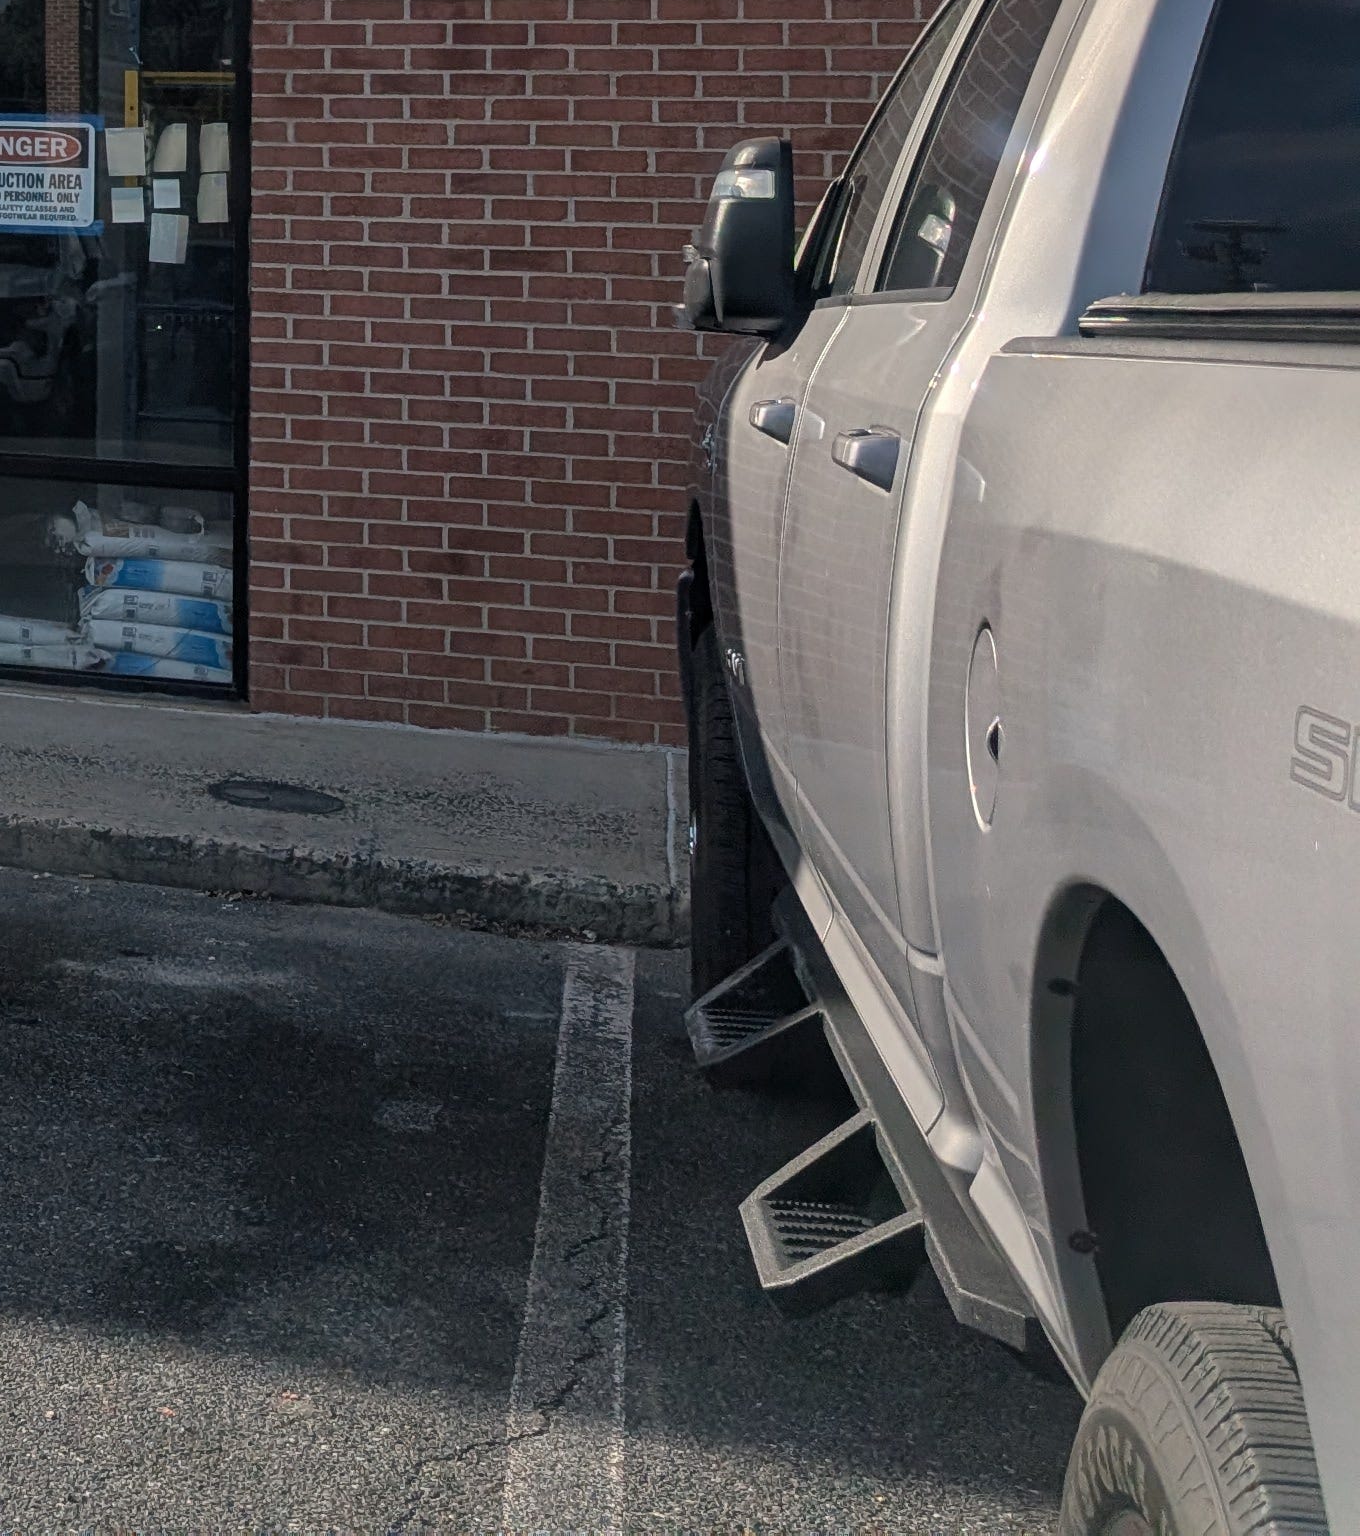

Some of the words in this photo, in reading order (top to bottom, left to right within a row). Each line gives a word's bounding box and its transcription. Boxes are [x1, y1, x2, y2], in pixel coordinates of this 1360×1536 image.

[48, 173, 83, 189] AREA
[4, 191, 54, 203] PERSONNEL
[57, 192, 80, 204] ONLY
[25, 205, 58, 213] GLASSES
[0, 212, 37, 220] FOOTWEAR
